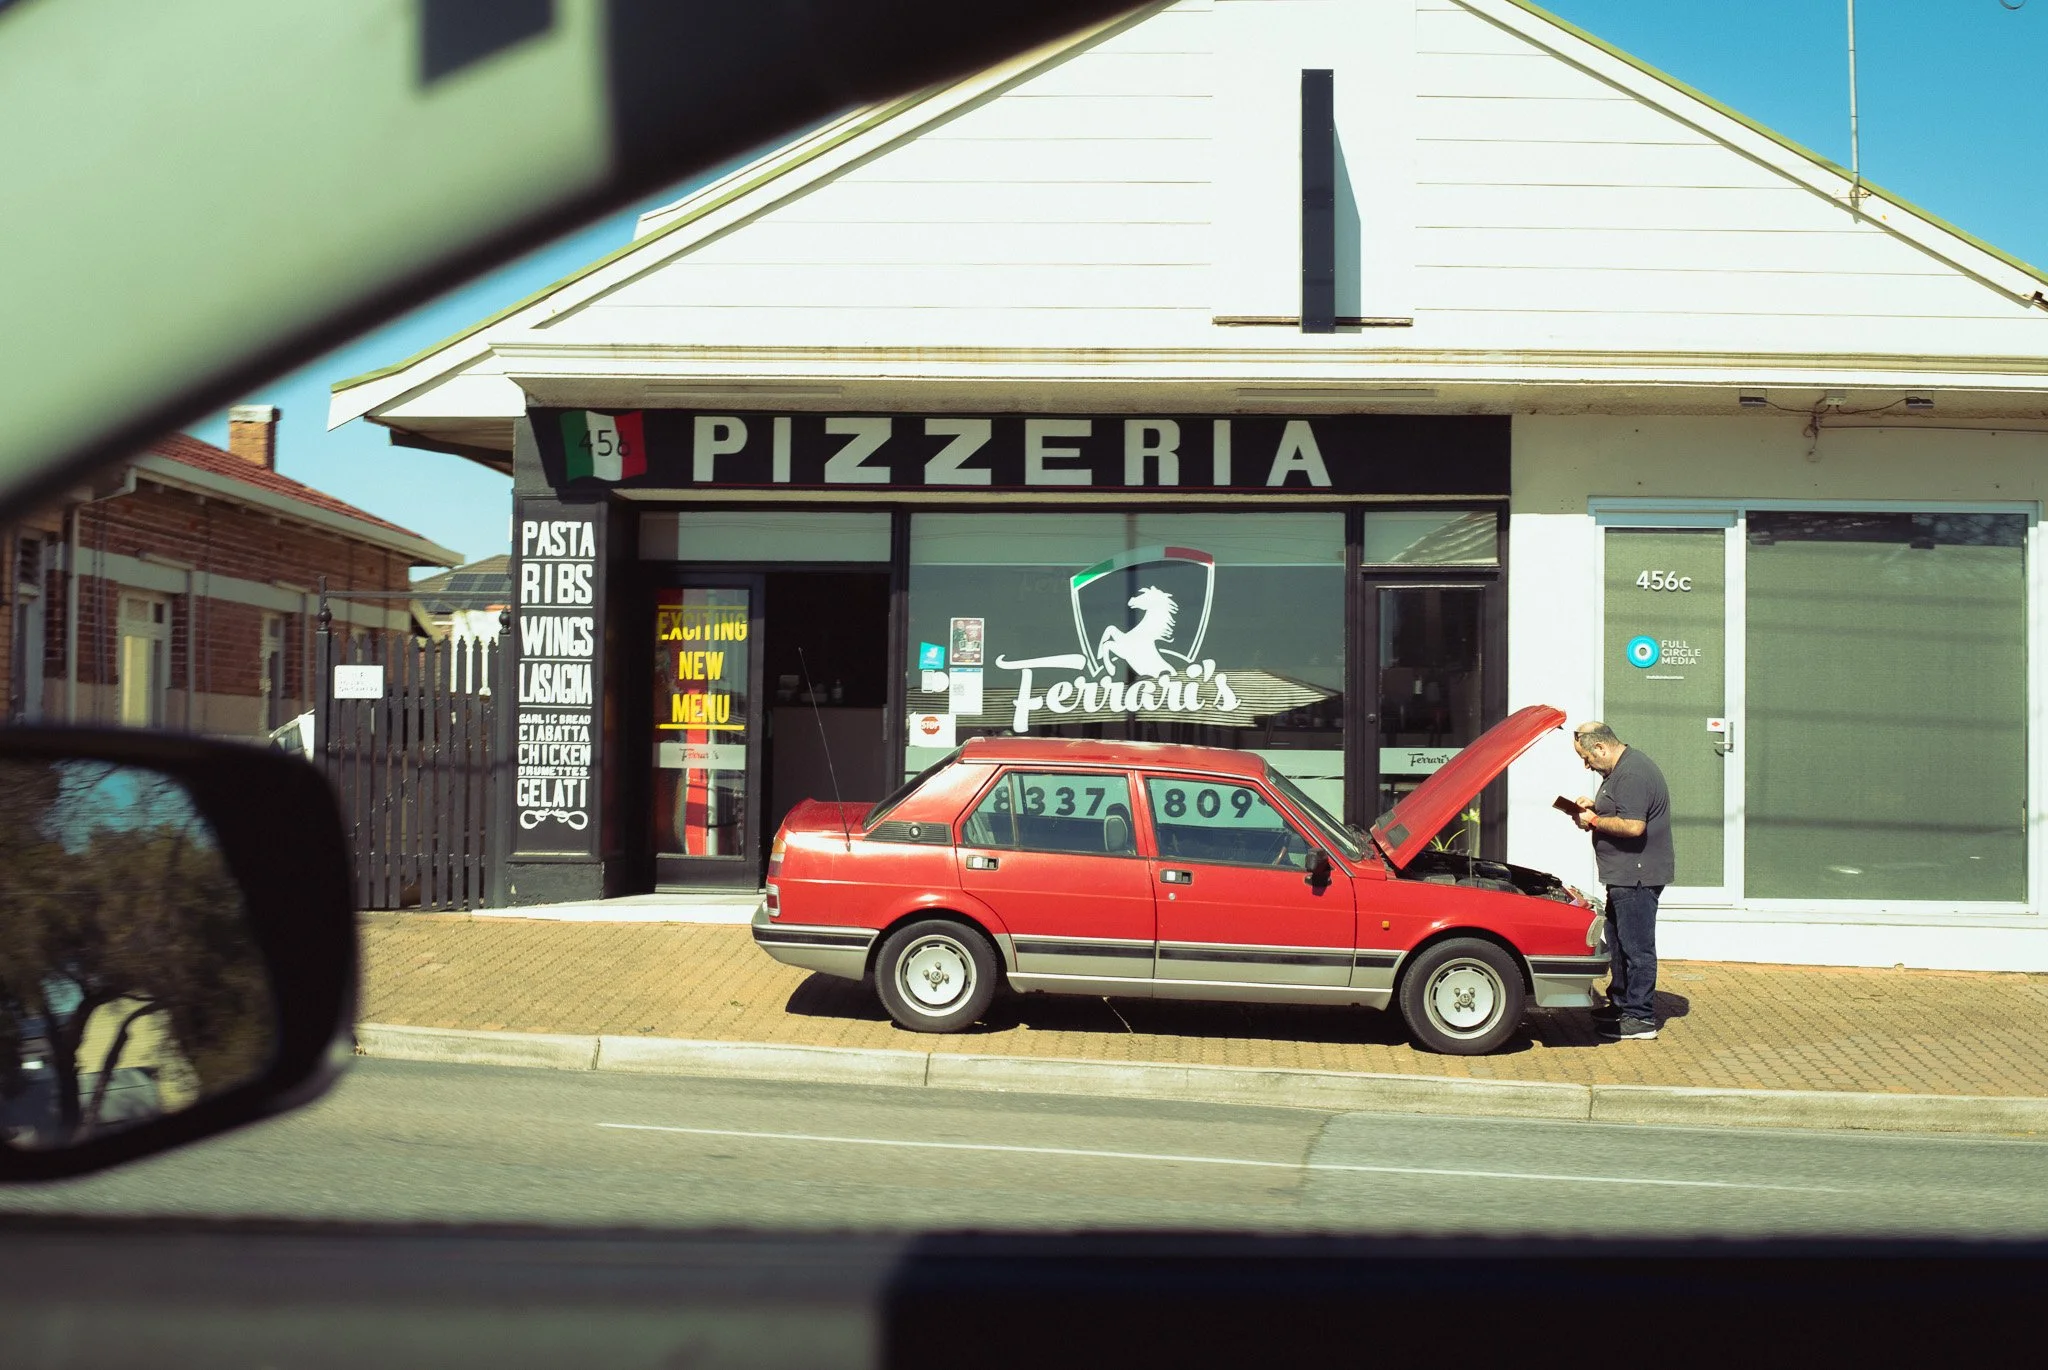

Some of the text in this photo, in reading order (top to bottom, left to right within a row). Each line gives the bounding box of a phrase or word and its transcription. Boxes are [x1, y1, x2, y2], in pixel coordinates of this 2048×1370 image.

[579, 430, 631, 457] 456
[693, 416, 1332, 486] PIZZERIA
[522, 521, 595, 557] PASTA
[521, 563, 593, 604] RIBS
[1636, 570, 1692, 591] 456c
[520, 616, 593, 657] WINGS
[658, 612, 747, 641] EXCITING
[1661, 640, 1689, 649] FULL
[1661, 649, 1701, 657] CIRCLE
[678, 651, 724, 680] NEW
[1661, 656, 1697, 665] MEDIA
[519, 663, 592, 704] LASAGNA
[995, 653, 1242, 733] Ferrari's
[519, 714, 591, 725] GARLIC BREAD
[671, 694, 730, 724] MENU
[519, 725, 590, 742] CIABATTA
[518, 744, 591, 766] CHICKEN
[518, 766, 588, 776] DRUMETTES
[517, 779, 586, 808] GELATI
[993, 786, 1106, 817] 8337
